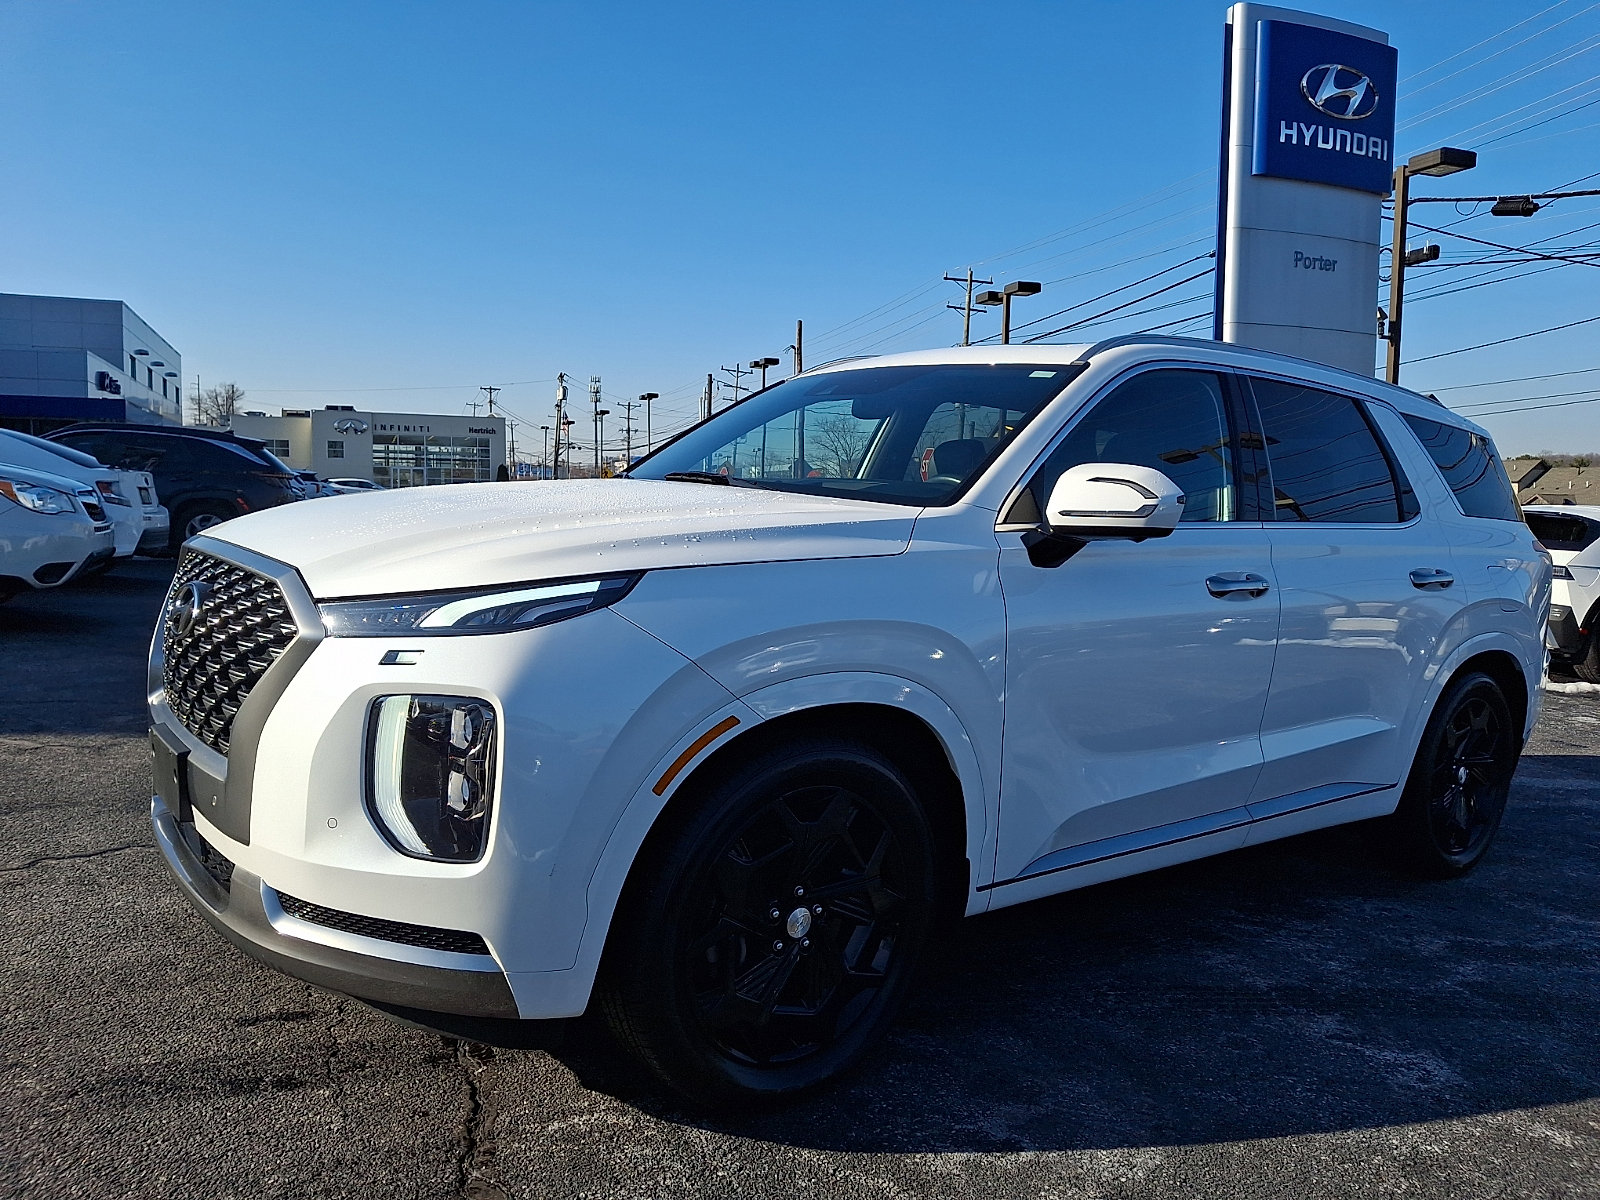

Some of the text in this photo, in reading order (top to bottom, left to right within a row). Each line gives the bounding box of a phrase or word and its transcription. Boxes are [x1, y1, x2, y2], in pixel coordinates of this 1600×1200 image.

[1280, 120, 1387, 161] HYUNDAI
[1294, 250, 1338, 272] Porter
[374, 424, 430, 432] INFINITI
